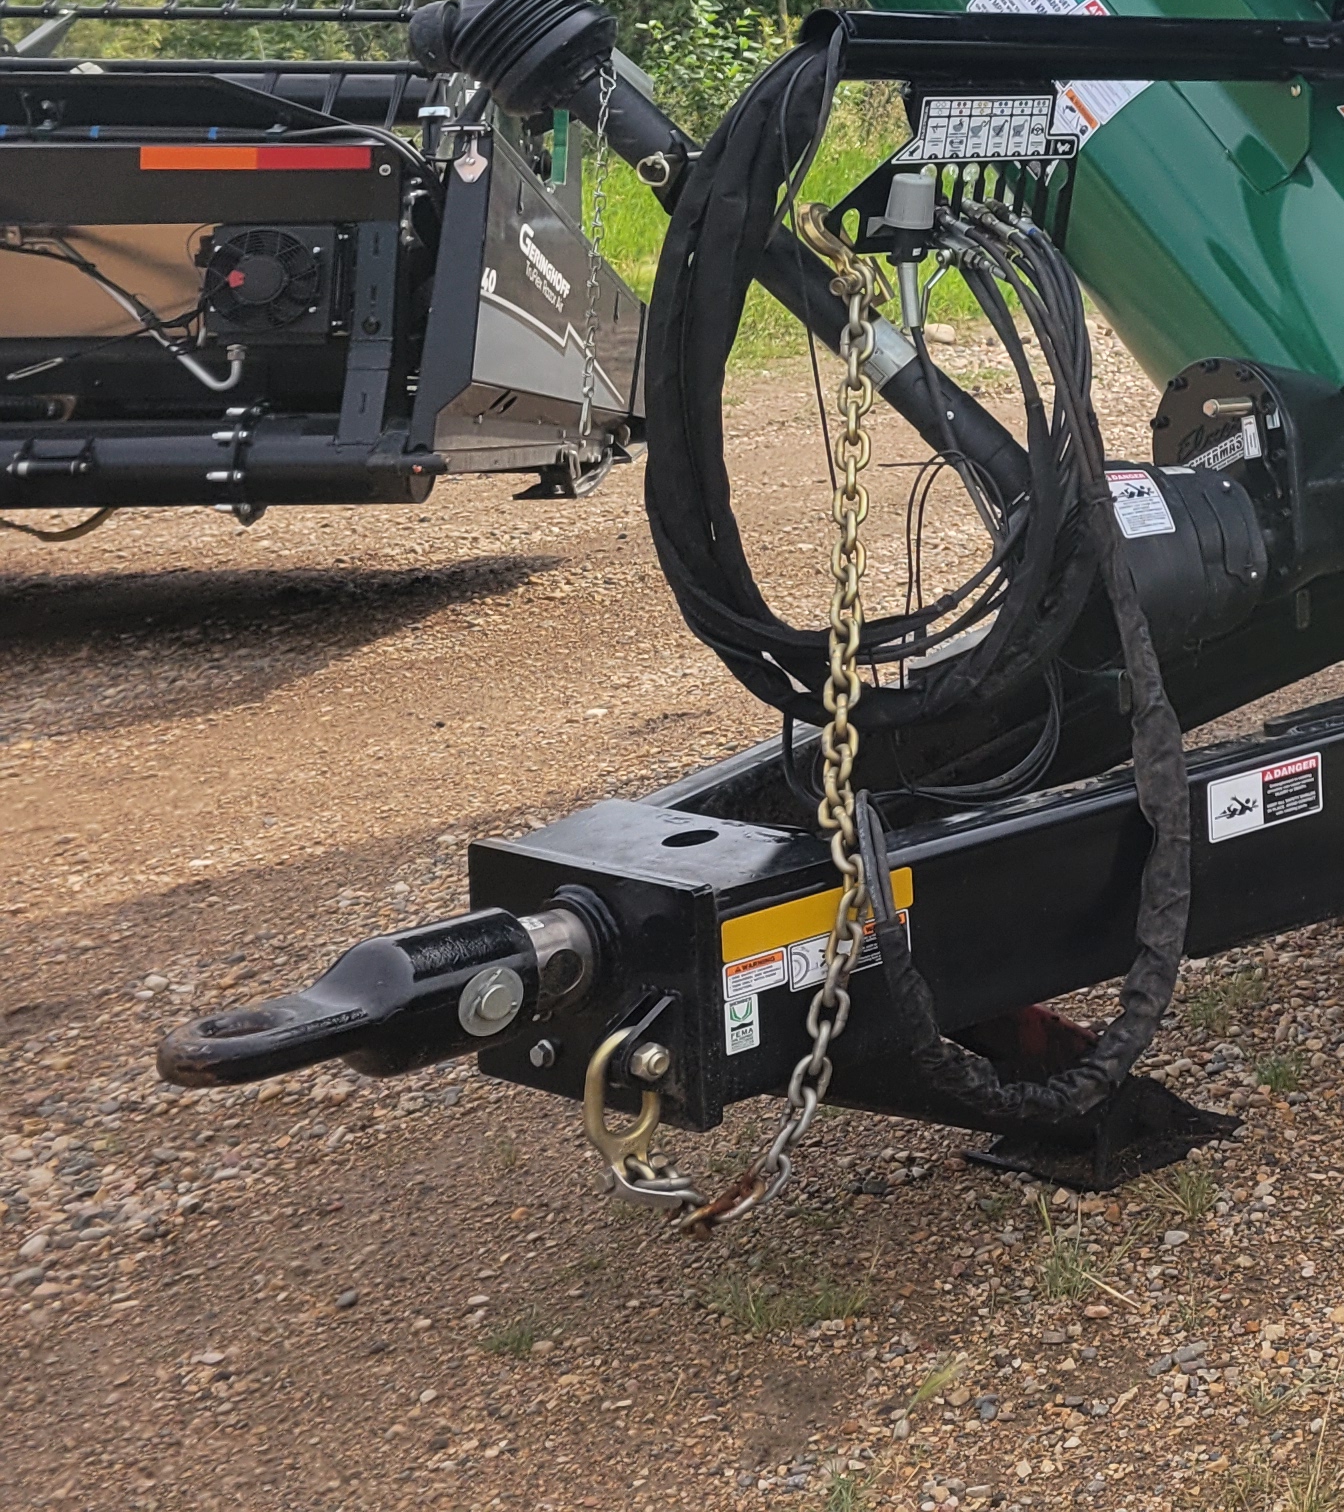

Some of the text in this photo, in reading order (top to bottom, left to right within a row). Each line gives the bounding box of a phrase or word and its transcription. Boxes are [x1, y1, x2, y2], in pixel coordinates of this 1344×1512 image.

[519, 223, 571, 299] GERINGHOFF
[1111, 473, 1146, 481] DANGER
[1273, 759, 1316, 779] DANGER
[741, 955, 775, 972] WARNING
[730, 1027, 754, 1040] FEMA
